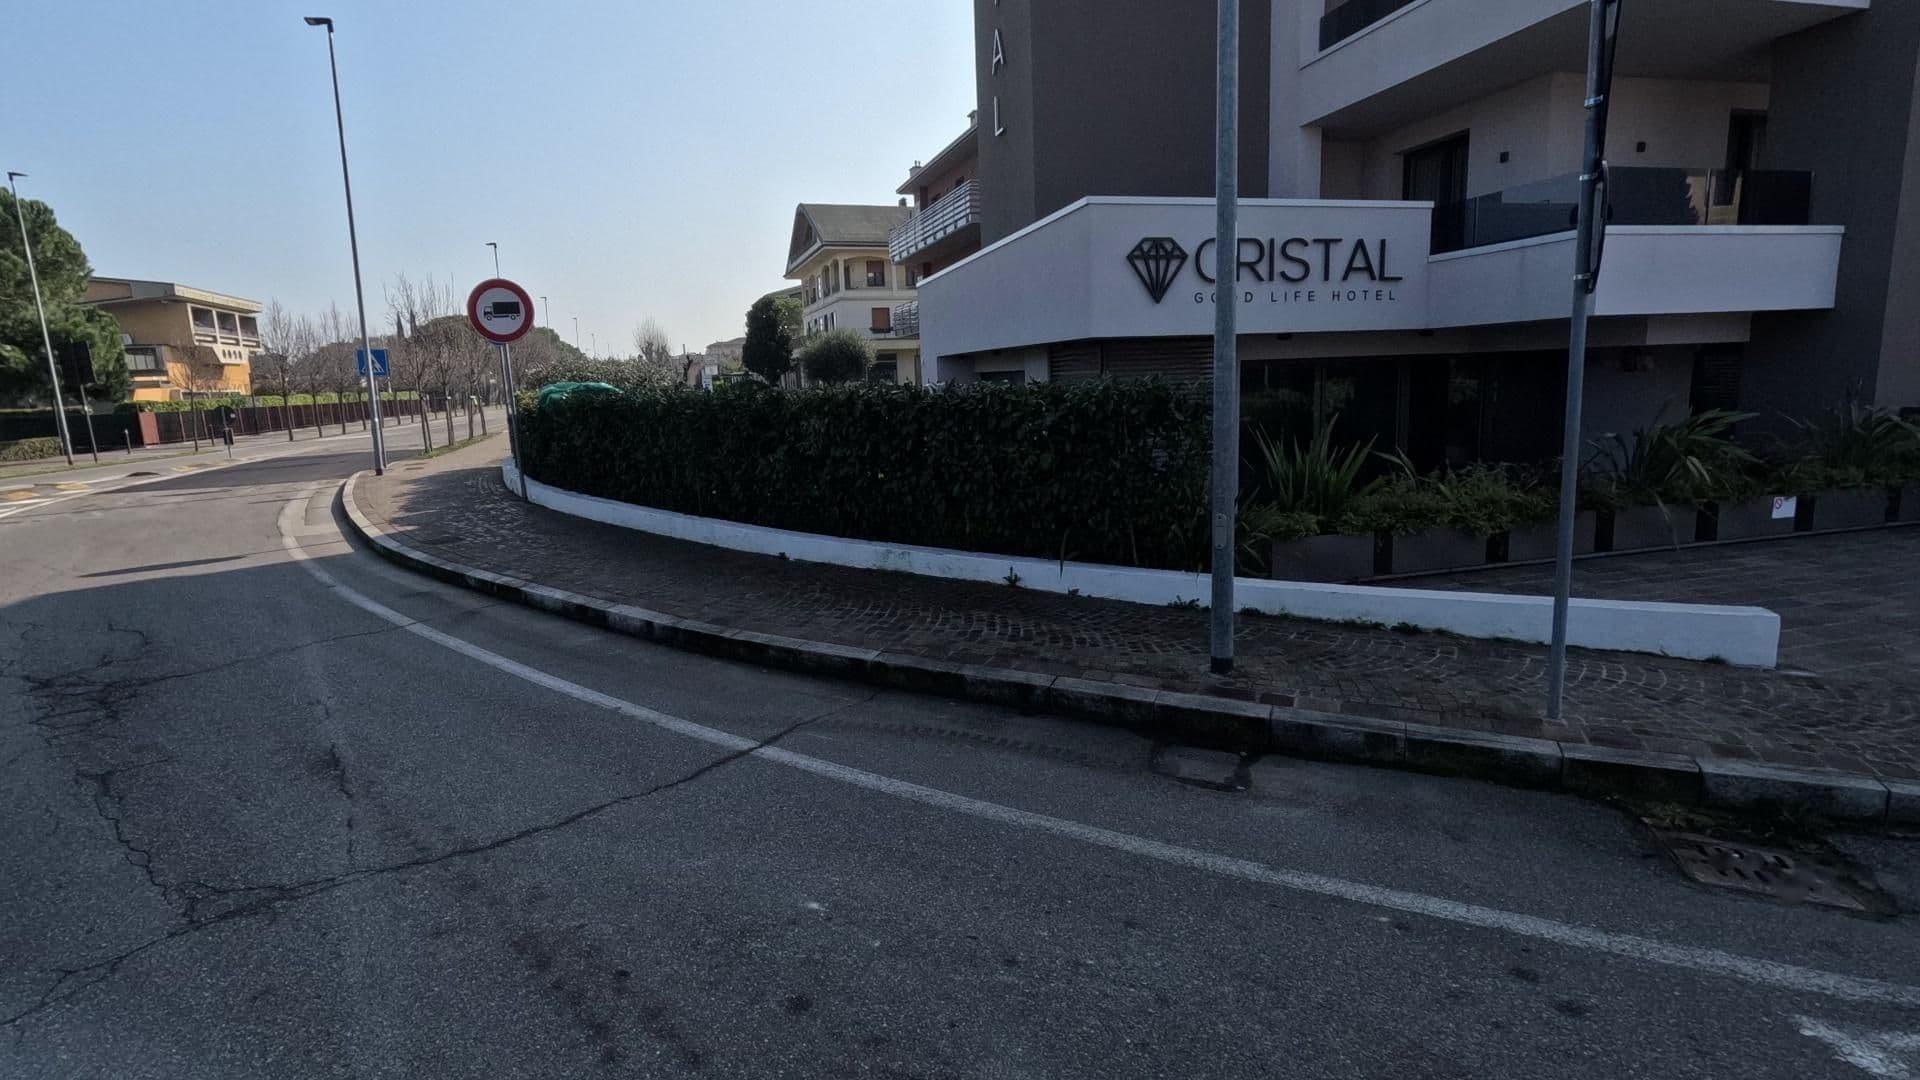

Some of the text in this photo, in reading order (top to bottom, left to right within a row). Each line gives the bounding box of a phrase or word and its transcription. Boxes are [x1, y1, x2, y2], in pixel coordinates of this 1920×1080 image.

[992, 0, 1005, 136] AL
[1194, 237, 1403, 283] CRISTAL
[1194, 289, 1395, 304] GD LIFE HOTEL
